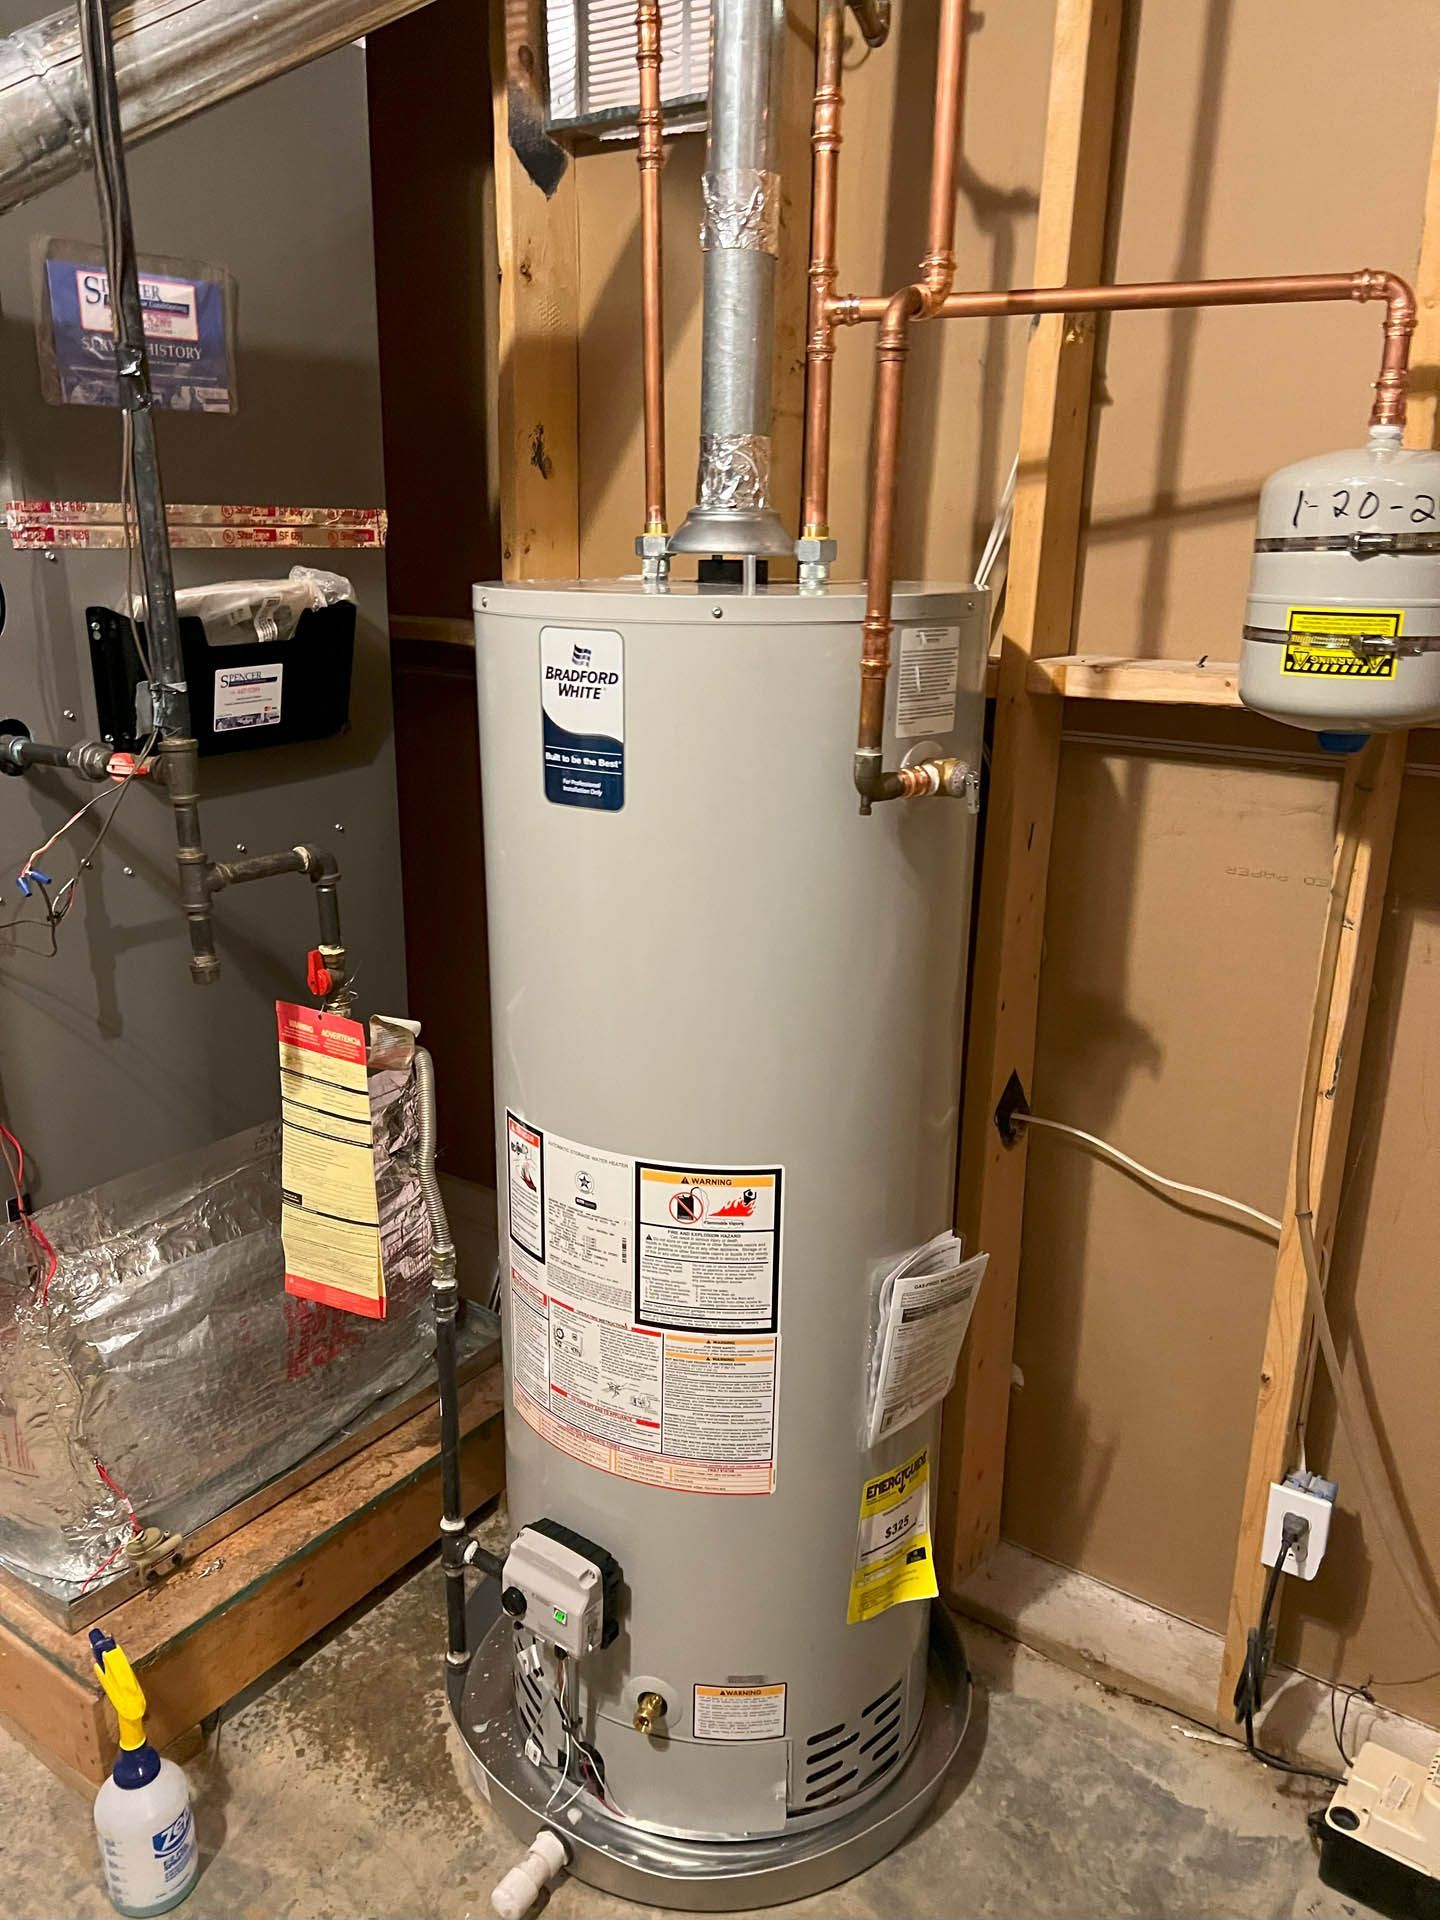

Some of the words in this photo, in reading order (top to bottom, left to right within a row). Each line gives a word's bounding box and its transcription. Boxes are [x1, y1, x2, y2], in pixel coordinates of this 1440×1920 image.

[220, 671, 262, 689] SPENCER
[545, 665, 619, 685] BRADFORD
[557, 682, 603, 700] WHITE
[545, 751, 561, 762] Built
[562, 754, 569, 763] to
[571, 754, 582, 765] be
[583, 756, 597, 766] the
[590, 789, 603, 797] Only
[691, 1177, 733, 1186] WARNING
[884, 1514, 910, 1540] $325
